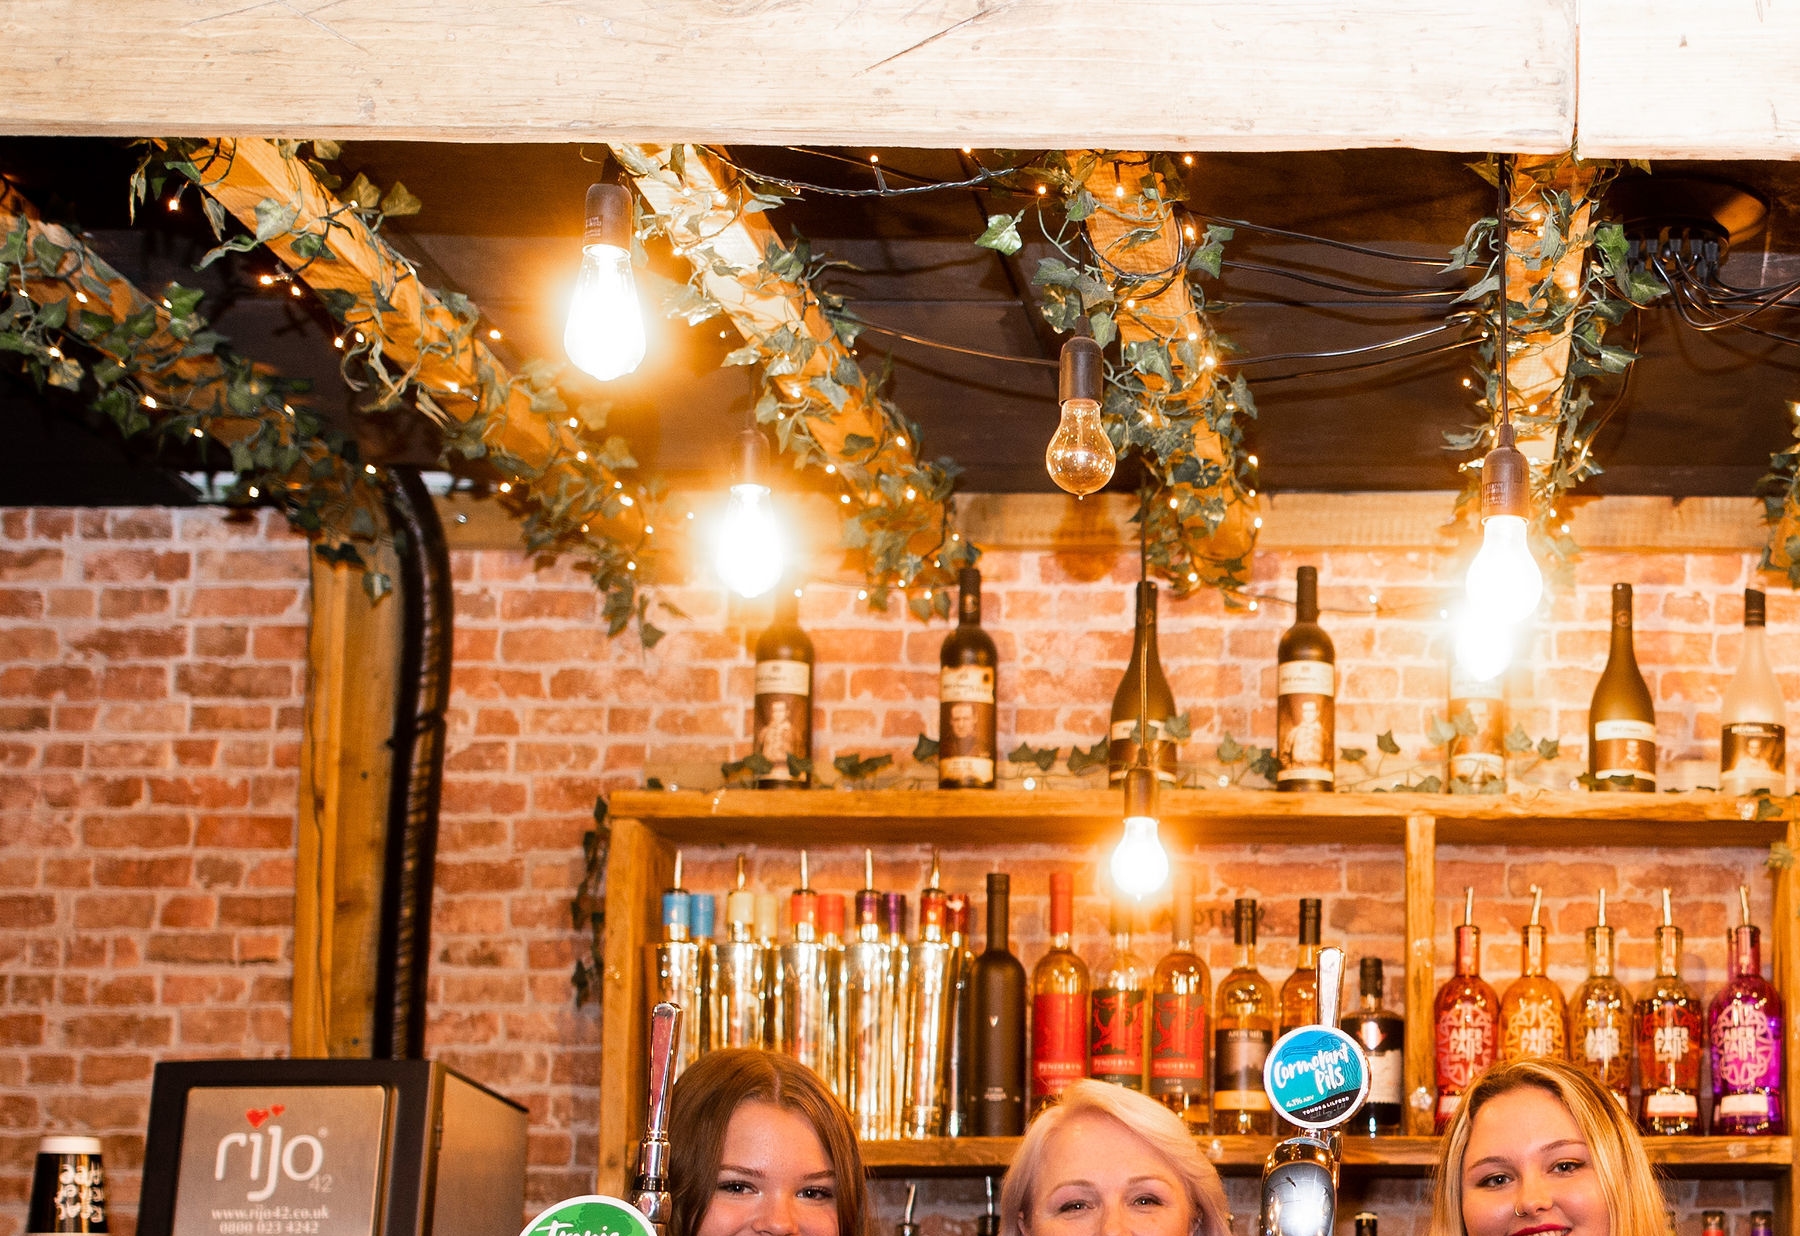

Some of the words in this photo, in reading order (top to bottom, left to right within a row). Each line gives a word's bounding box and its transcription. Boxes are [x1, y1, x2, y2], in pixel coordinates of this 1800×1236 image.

[1273, 1042, 1350, 1089] Cormorant
[1315, 1064, 1345, 1095] Pils
[1302, 1106, 1322, 1116] TOMOS
[1326, 1096, 1350, 1108] LILFORD
[308, 1174, 333, 1193] 42
[212, 1205, 329, 1220] www.rijo42.co.uk
[219, 1221, 252, 1234] 0800
[257, 1221, 281, 1234] 023
[286, 1221, 319, 1234] 4242
